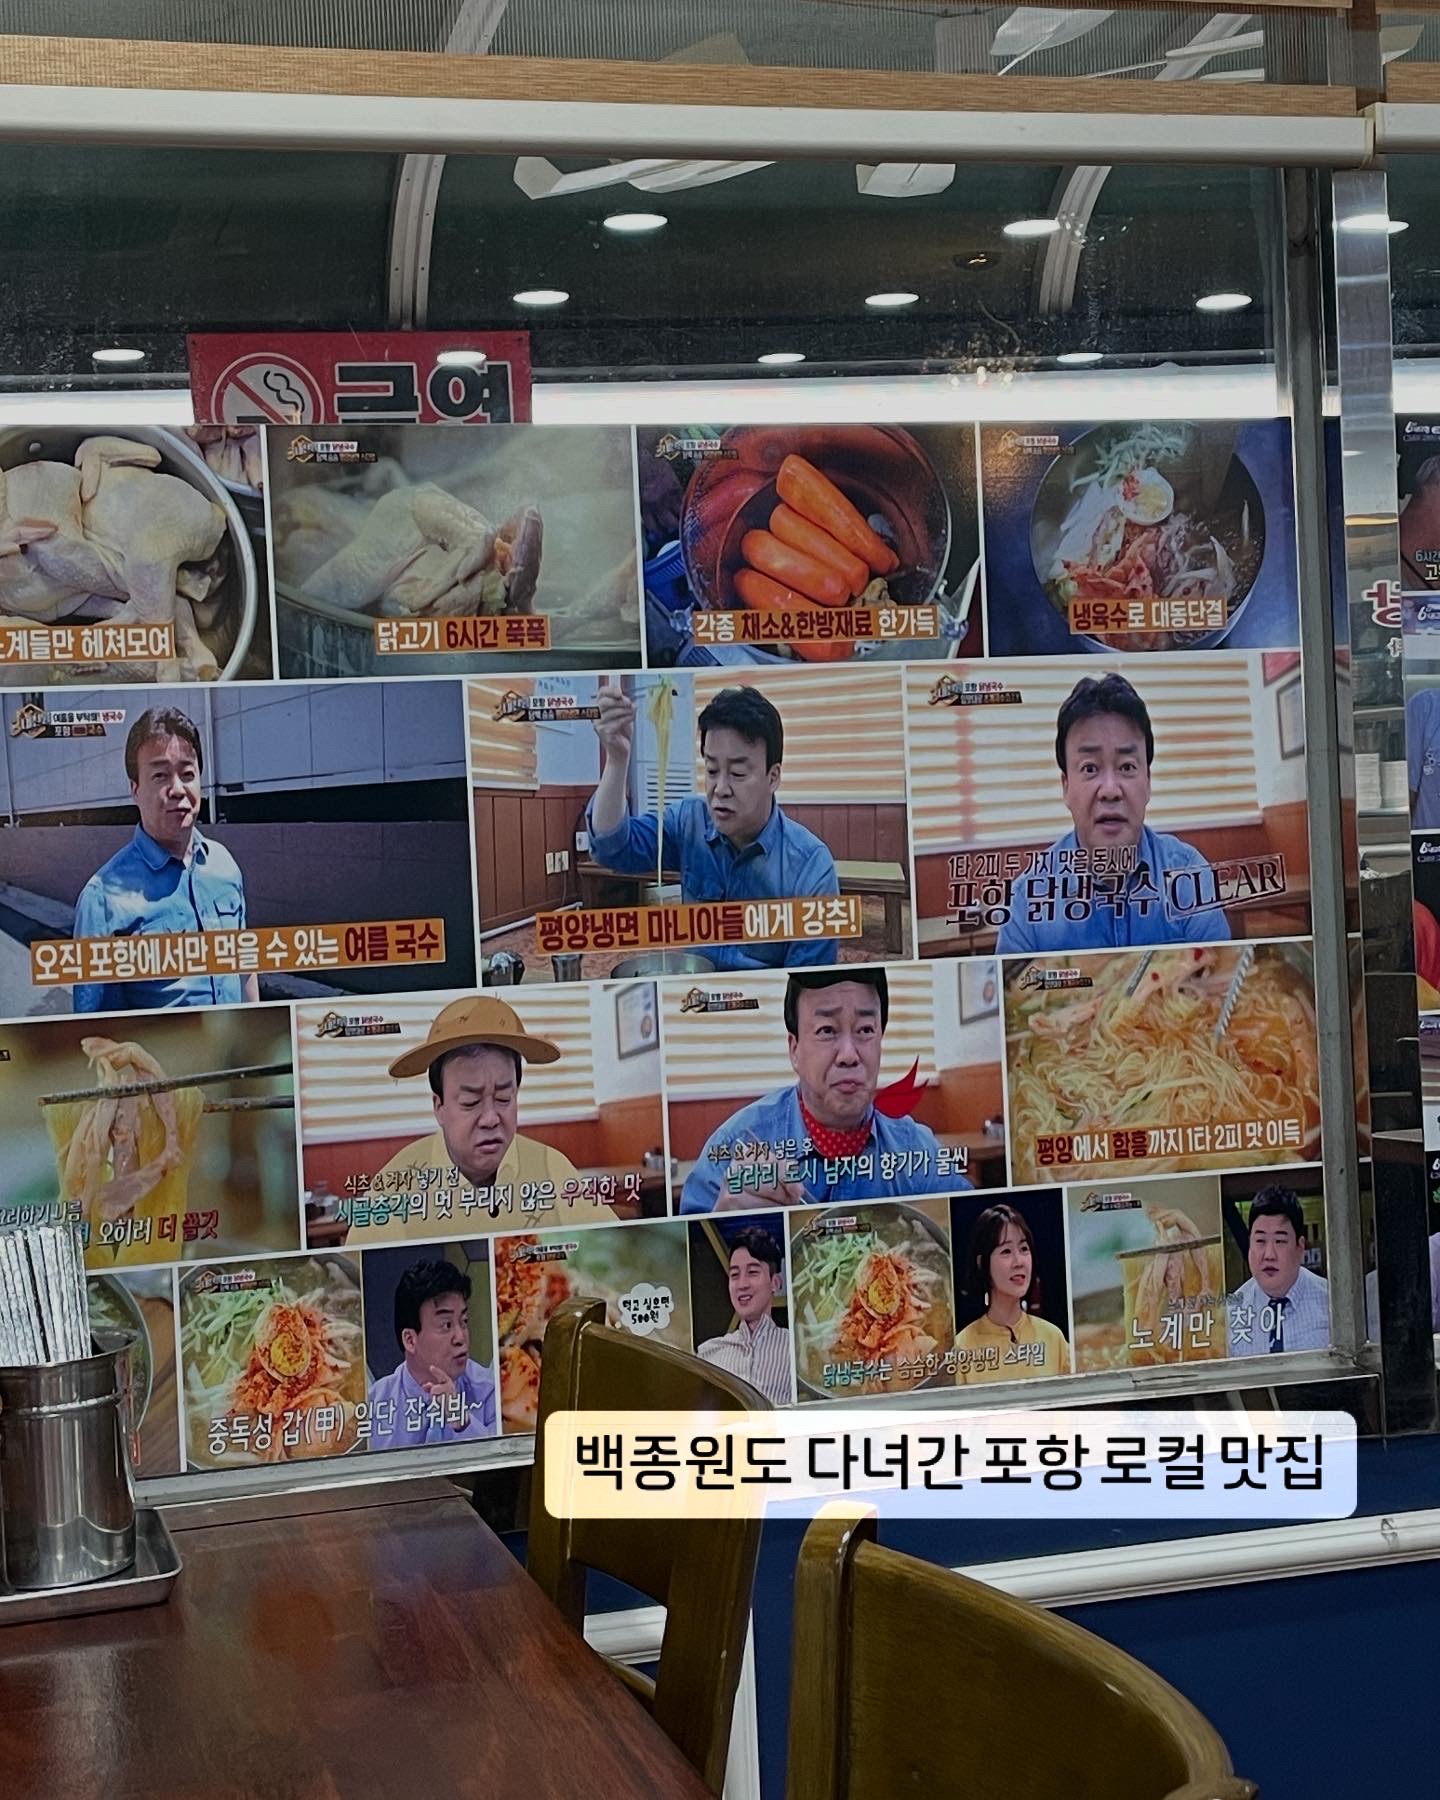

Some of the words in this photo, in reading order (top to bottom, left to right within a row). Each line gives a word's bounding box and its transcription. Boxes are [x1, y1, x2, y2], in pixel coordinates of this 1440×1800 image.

[377, 620, 440, 652] 닭고기
[446, 619, 500, 649] 6시간
[505, 617, 547, 648] 푹푹
[696, 613, 735, 641] 각종
[741, 608, 873, 640] 채소&한방재료
[878, 607, 935, 636] 한가득
[1073, 600, 1145, 630] 냉육수로
[1151, 598, 1223, 628] 대동단결
[80, 625, 172, 658] 헤쳐모여
[948, 855, 970, 879] 1타
[975, 852, 1000, 878] 2피
[1004, 853, 1021, 875] 두
[1024, 850, 1054, 876] 가지
[1057, 848, 1088, 874] 맛을
[1091, 846, 1138, 874] 동시에
[945, 879, 1016, 926] 포항
[1026, 873, 1160, 922] 닭냉국수
[1170, 860, 1281, 913] CLEAR
[538, 910, 640, 951] 평양냉면
[647, 903, 794, 943] 마니아들에게
[801, 898, 857, 936] 강추!
[35, 951, 83, 981] 오직
[89, 939, 209, 977] 포항에서만
[213, 931, 260, 971] 먹을
[265, 933, 289, 968] 수
[293, 929, 340, 967] 있는
[344, 925, 389, 962] 여름
[395, 922, 440, 960] 국수
[774, 1138, 798, 1160] 넣은
[802, 1135, 814, 1157] 후
[1037, 1133, 1110, 1165] 평양에서
[1112, 1128, 1184, 1158] 함흥까지
[1187, 1126, 1212, 1153] 1타
[1215, 1124, 1242, 1150] 2피
[1245, 1121, 1263, 1147] 맛
[1266, 1118, 1301, 1146] 이득
[416, 1167, 443, 1190] 넣기
[446, 1165, 460, 1187] 전
[726, 1161, 778, 1195] 날라리
[783, 1157, 818, 1185] 도시
[823, 1152, 874, 1186] 남자의
[880, 1149, 931, 1181] 향기가
[935, 1145, 969, 1176] 물씬
[334, 1191, 429, 1228] 시골총각의
[434, 1189, 452, 1219] 멋
[458, 1183, 514, 1217] 부리지
[519, 1180, 556, 1212] 않은
[560, 1175, 618, 1208] 우직한
[624, 1172, 642, 1203] 맛
[97, 1216, 152, 1246] 오히려
[157, 1213, 177, 1242] 더
[182, 1209, 219, 1241] 쫄깃
[622, 1298, 640, 1312] 먹고
[631, 1309, 660, 1325] 500원
[1128, 1309, 1215, 1351] 노계만
[1230, 1302, 1286, 1346] 찾아
[822, 1359, 892, 1389] 닭냉국수는
[897, 1353, 941, 1381] 슴슴한
[942, 1346, 1000, 1375] 평양냉면
[1003, 1342, 1046, 1366] 스타일
[207, 1413, 272, 1455] 중독성
[282, 1403, 346, 1447] 갑(甲)
[353, 1397, 397, 1438] 일단
